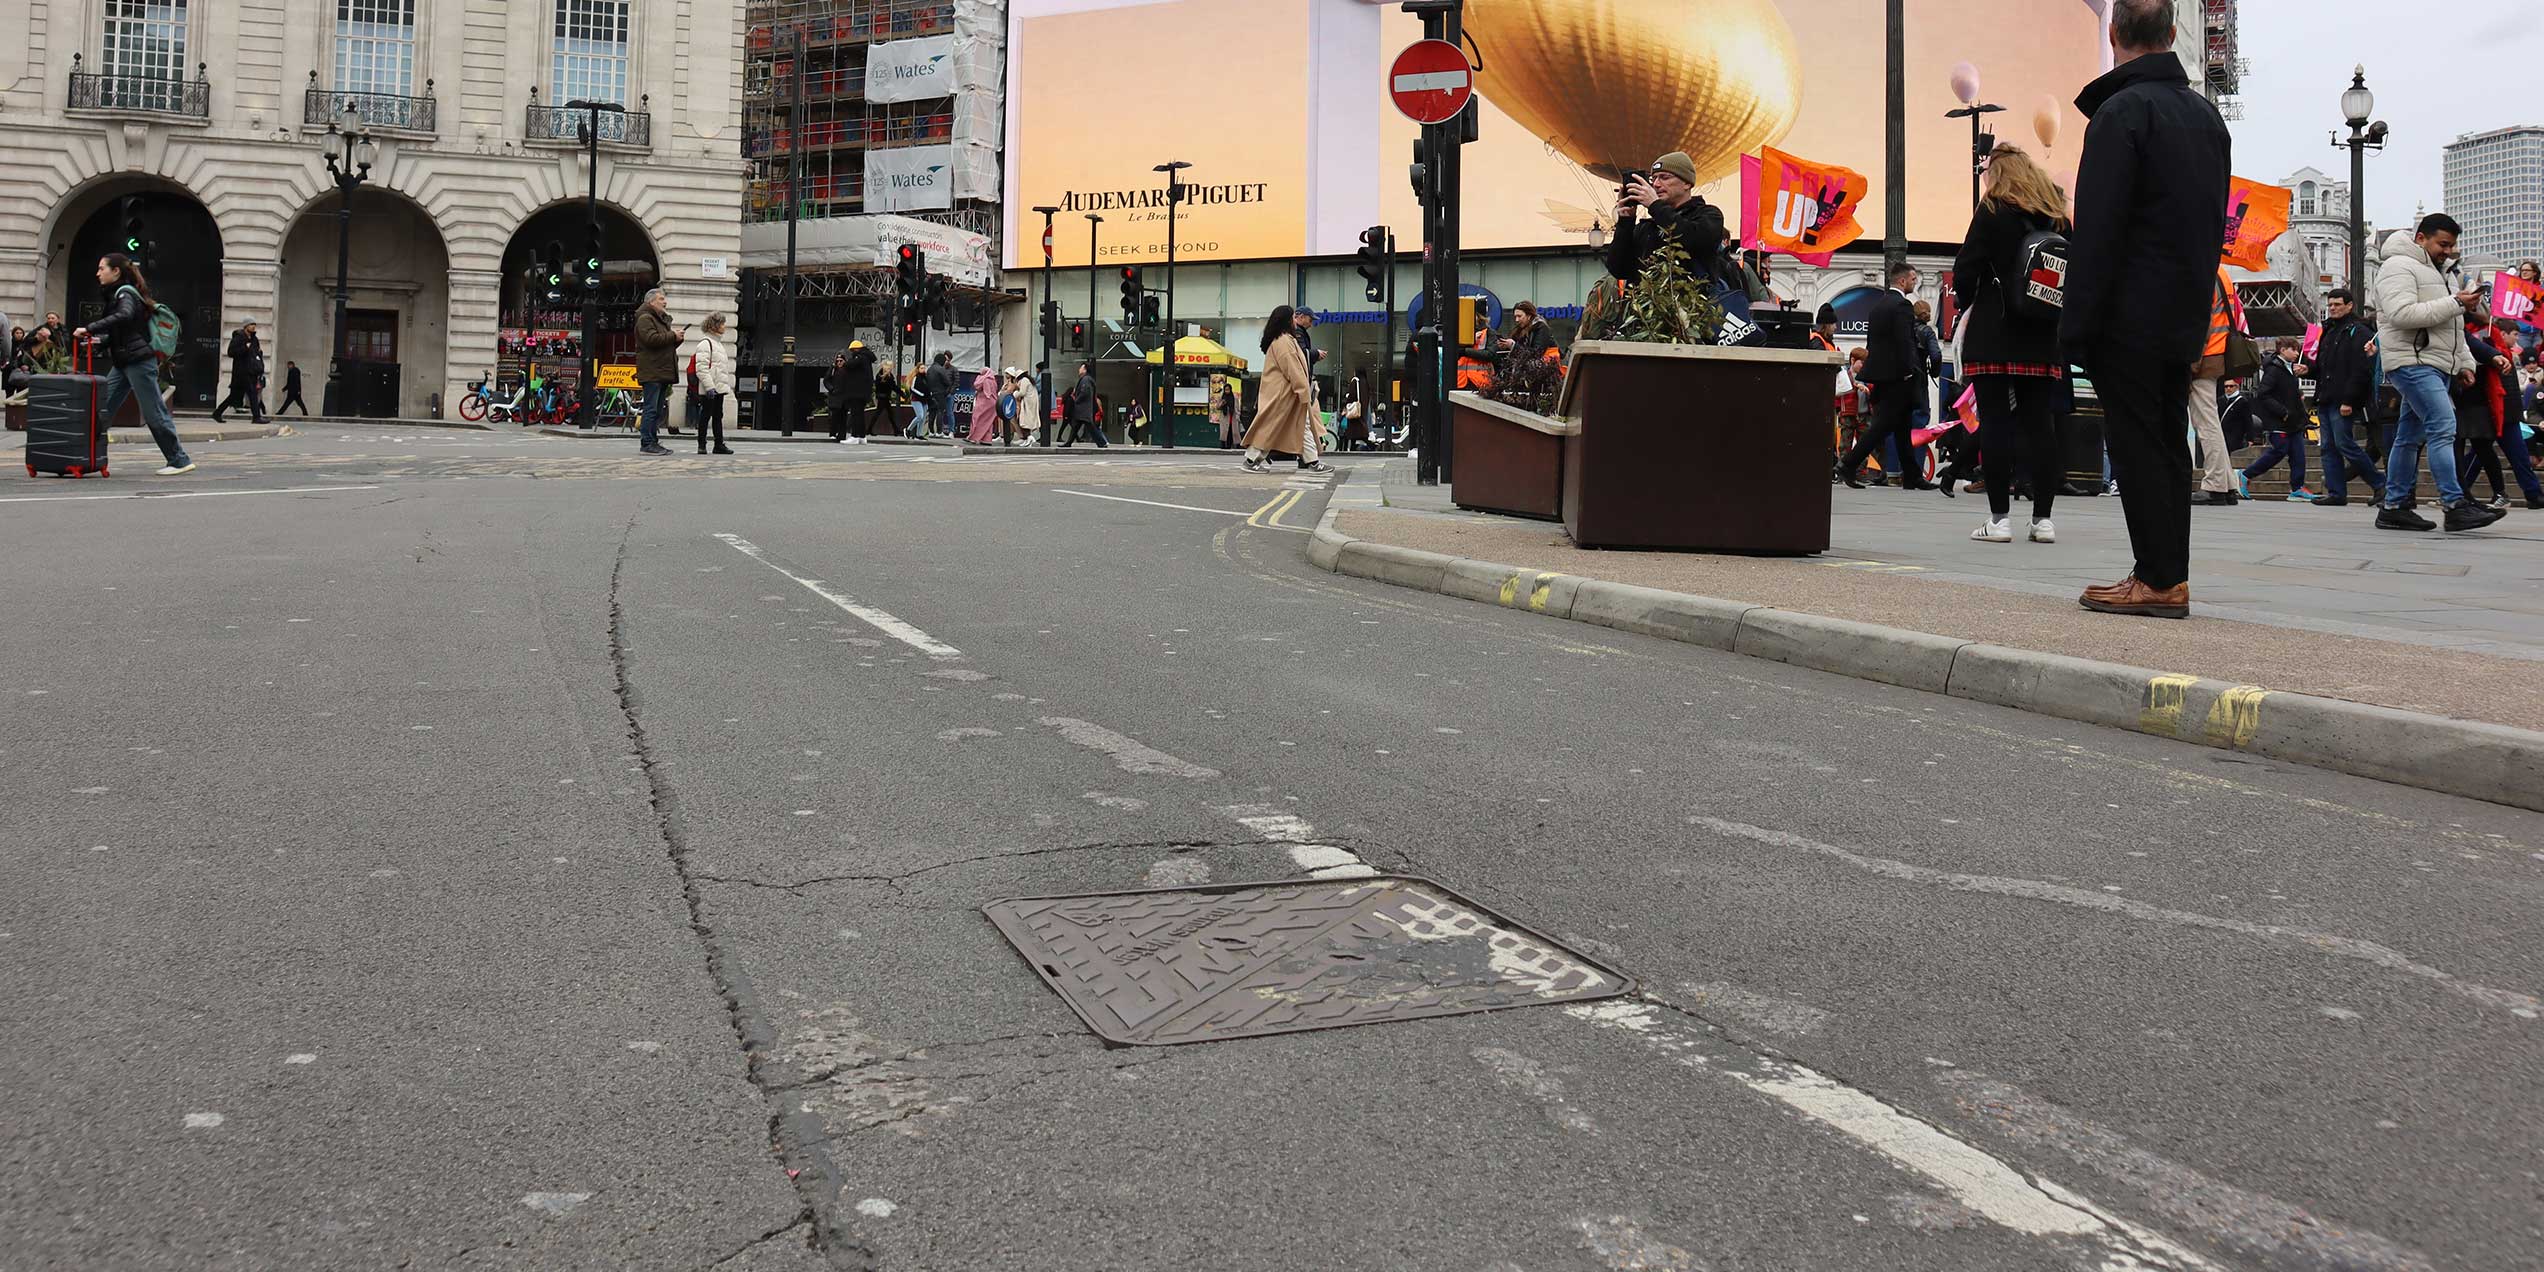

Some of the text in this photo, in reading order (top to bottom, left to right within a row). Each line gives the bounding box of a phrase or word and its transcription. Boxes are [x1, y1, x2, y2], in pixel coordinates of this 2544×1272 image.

[895, 63, 936, 80] Wates
[892, 172, 934, 188] Wates
[1780, 162, 1847, 203] PAY
[1184, 182, 1268, 206] PIGUET
[1129, 212, 1143, 222] Le
[1099, 241, 1219, 256] SEEK BEYOND
[1536, 303, 1584, 322] eauty
[1718, 323, 1757, 346] adidas
[1188, 355, 1210, 363] DOG
[602, 369, 631, 378] Diverted
